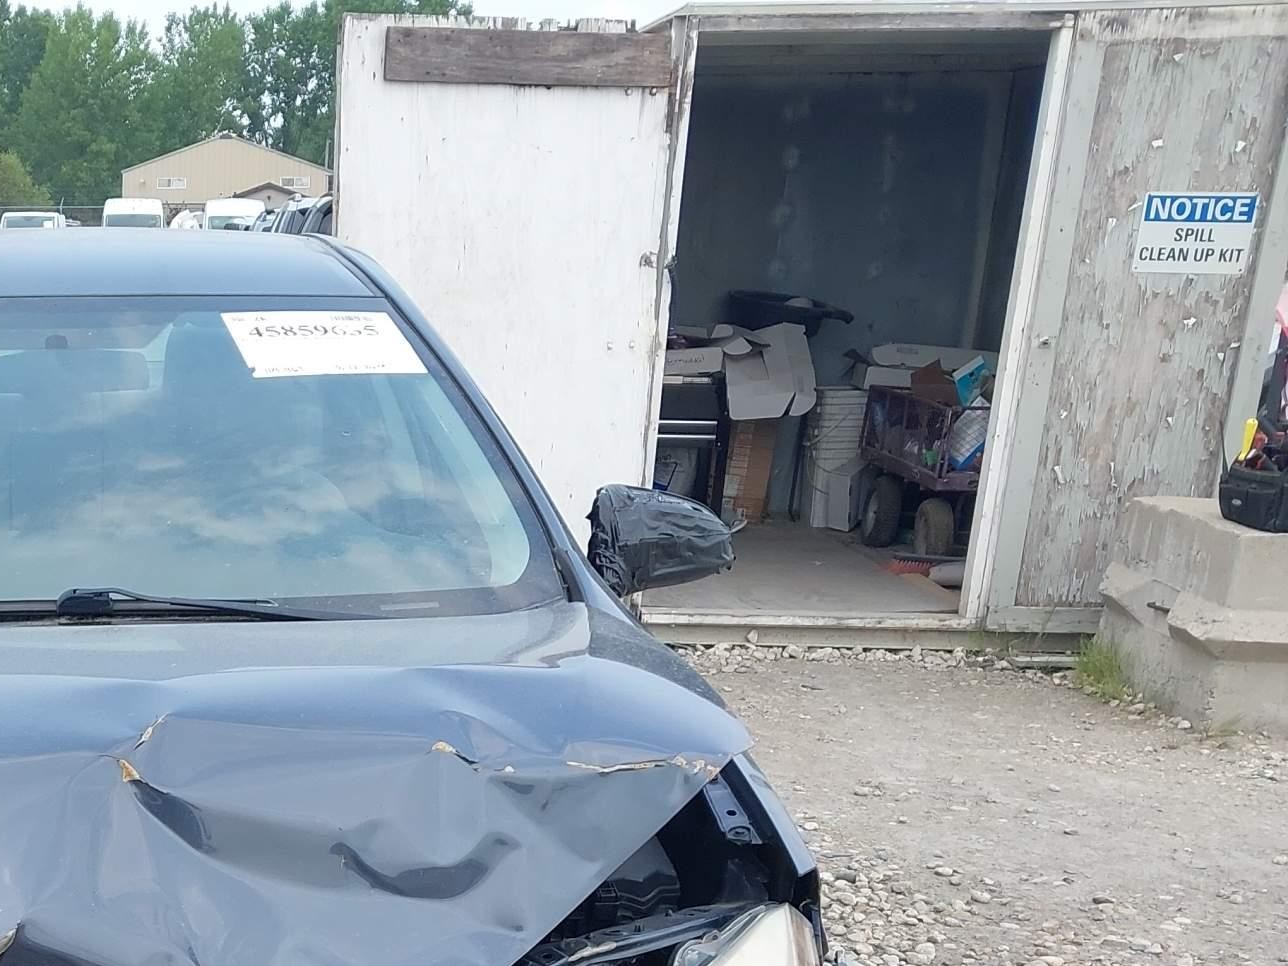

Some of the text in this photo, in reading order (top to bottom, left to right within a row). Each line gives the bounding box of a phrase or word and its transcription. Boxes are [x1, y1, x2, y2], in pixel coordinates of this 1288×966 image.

[1149, 197, 1251, 221] NOTICE
[1174, 227, 1215, 242] SPILL
[1139, 247, 1244, 263] CLEAN UP KIT
